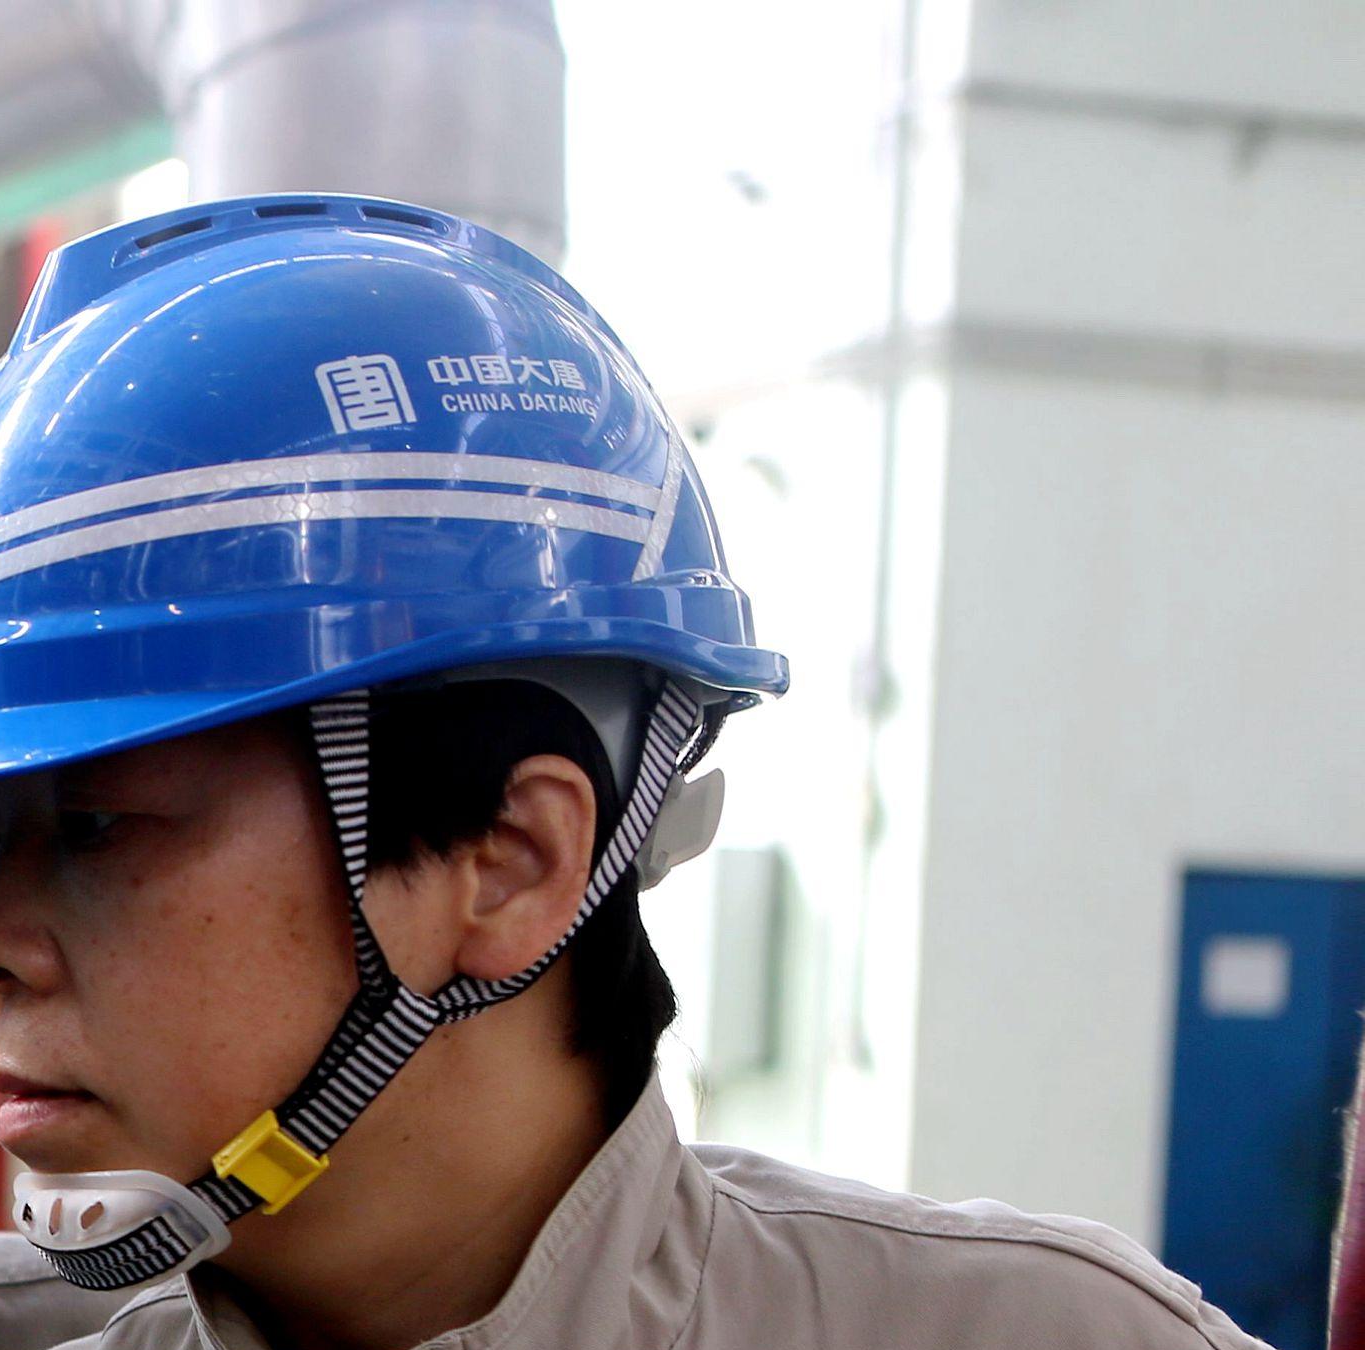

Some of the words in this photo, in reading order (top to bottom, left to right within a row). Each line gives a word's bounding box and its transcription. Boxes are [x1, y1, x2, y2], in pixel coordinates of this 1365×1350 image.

[427, 355, 586, 391] 中国大唐
[441, 393, 515, 413] CHINA
[519, 393, 598, 416] DATANG
